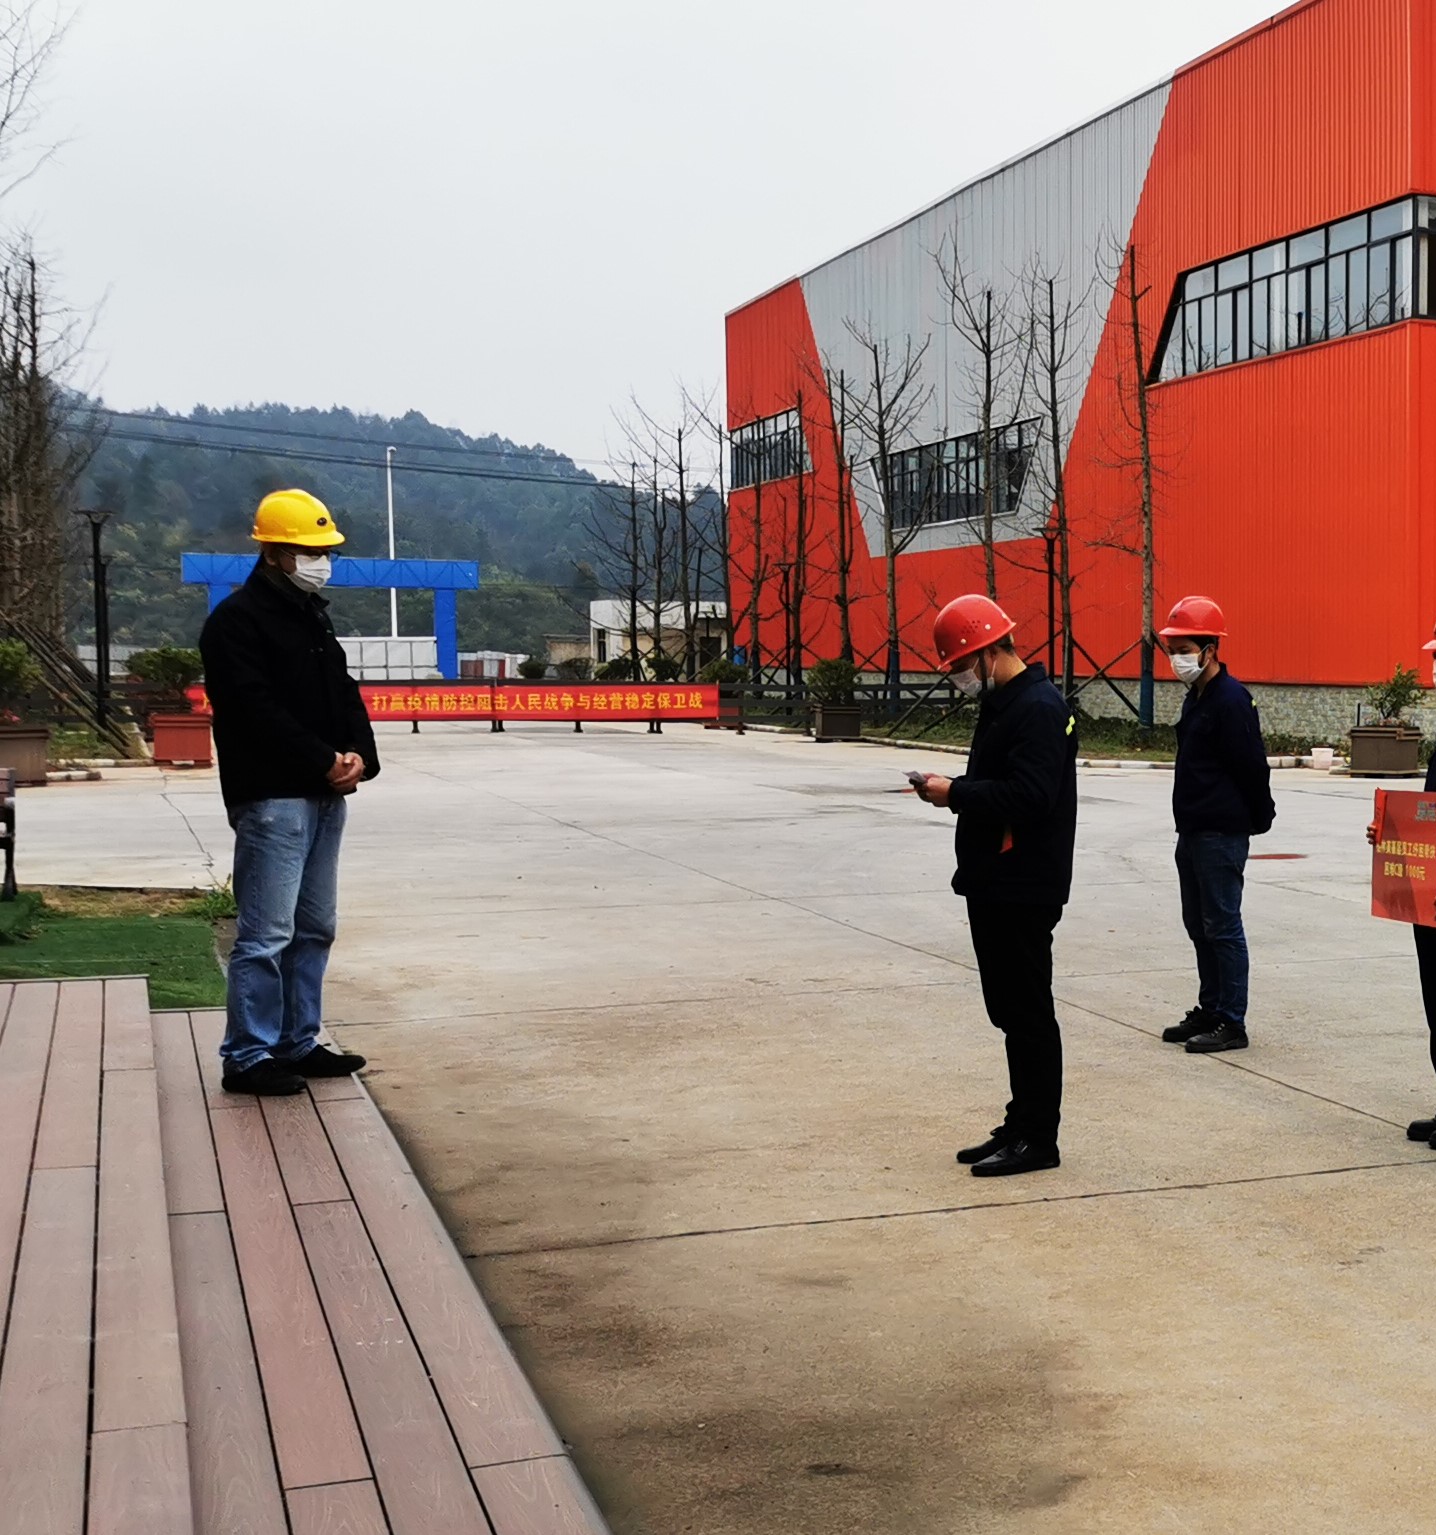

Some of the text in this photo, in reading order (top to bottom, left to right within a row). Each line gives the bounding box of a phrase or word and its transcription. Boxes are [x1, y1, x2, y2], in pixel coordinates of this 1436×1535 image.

[372, 692, 703, 711] 打赢疫情防控阻击人民战争与经营稳定保卫战
